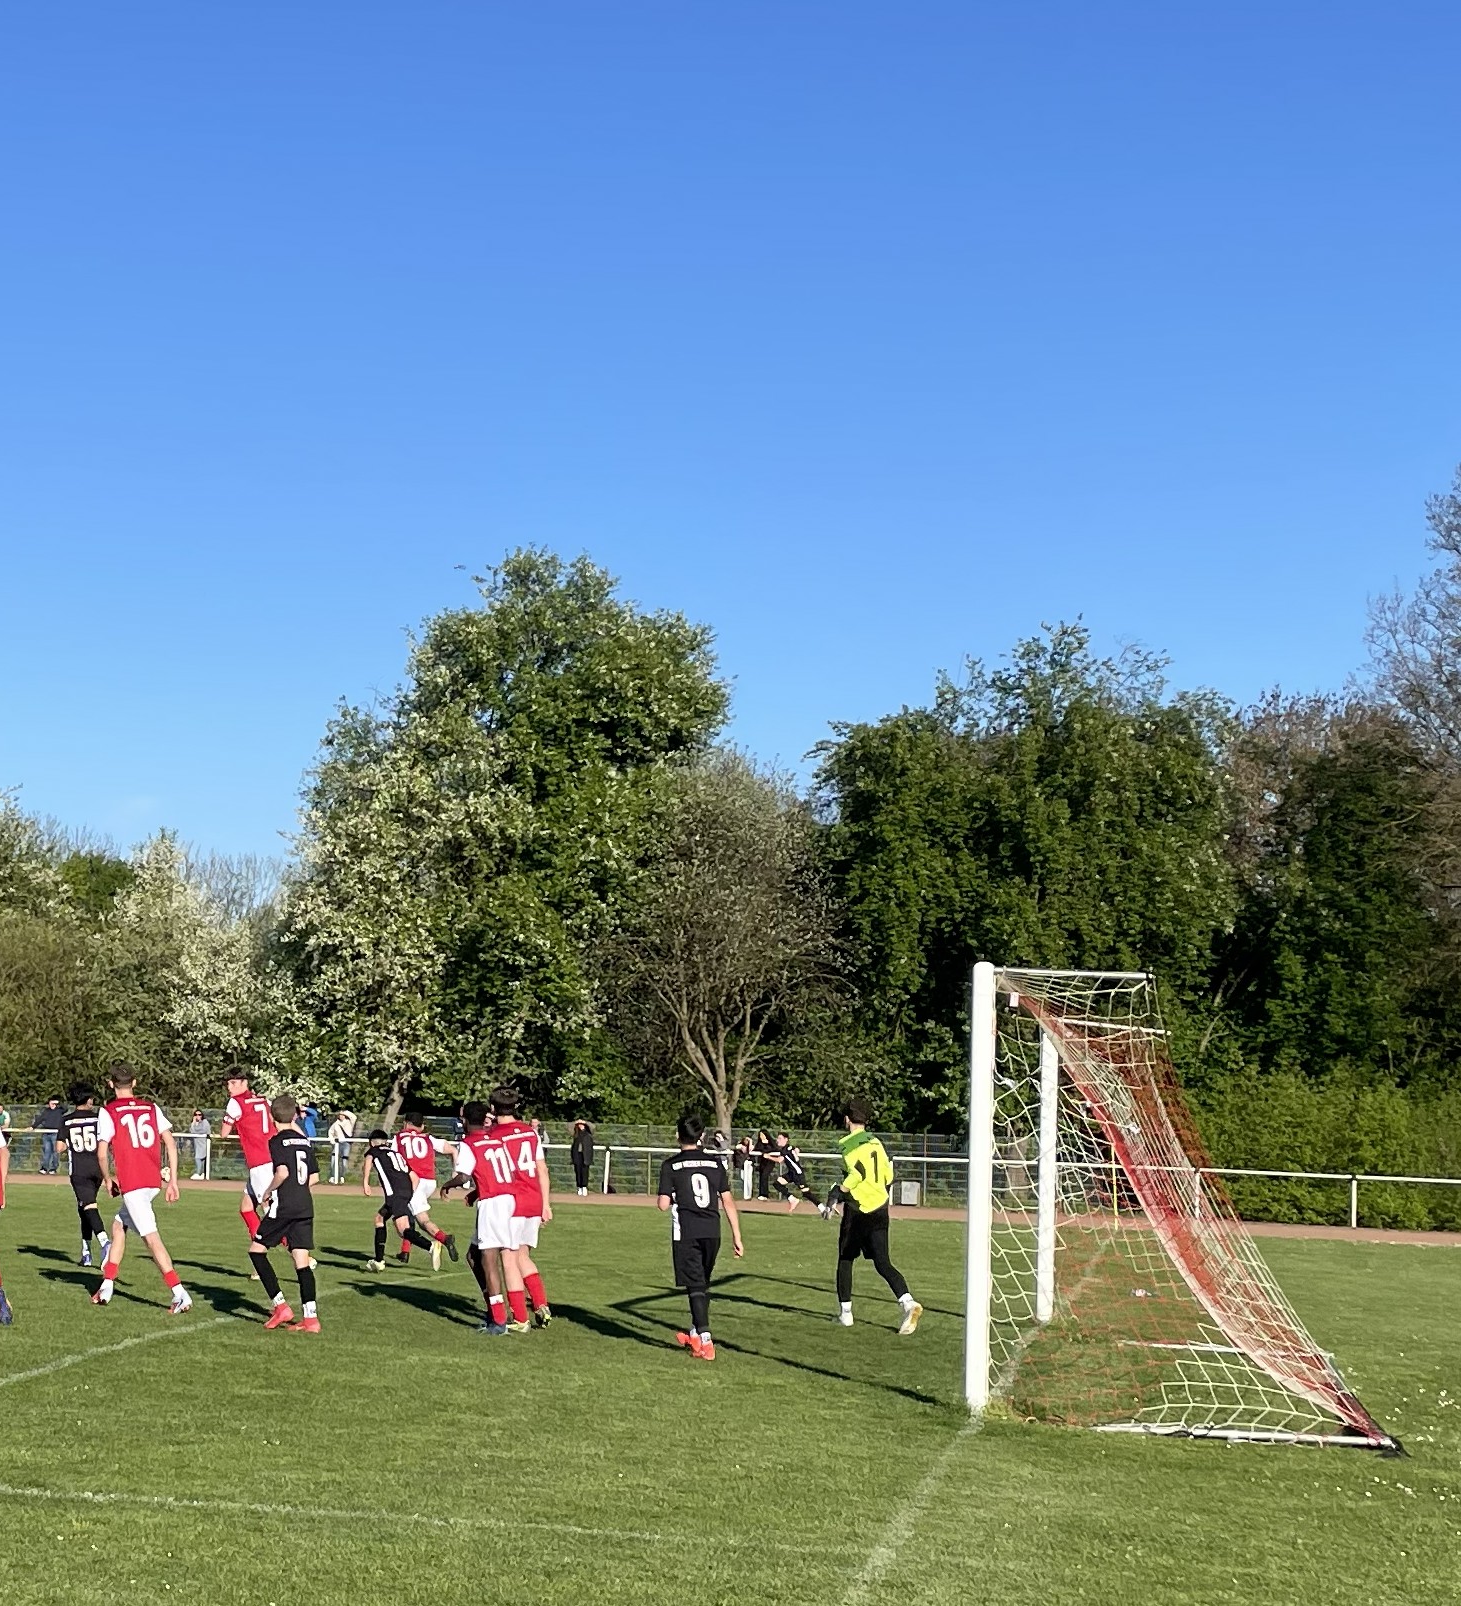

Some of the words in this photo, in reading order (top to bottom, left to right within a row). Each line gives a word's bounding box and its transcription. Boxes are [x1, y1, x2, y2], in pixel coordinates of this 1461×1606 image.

[120, 1113, 156, 1148] 16
[254, 1103, 269, 1134] 7
[69, 1126, 97, 1152] 55
[401, 1137, 429, 1159] 10
[484, 1147, 513, 1184] 11
[691, 1173, 711, 1208] 9
